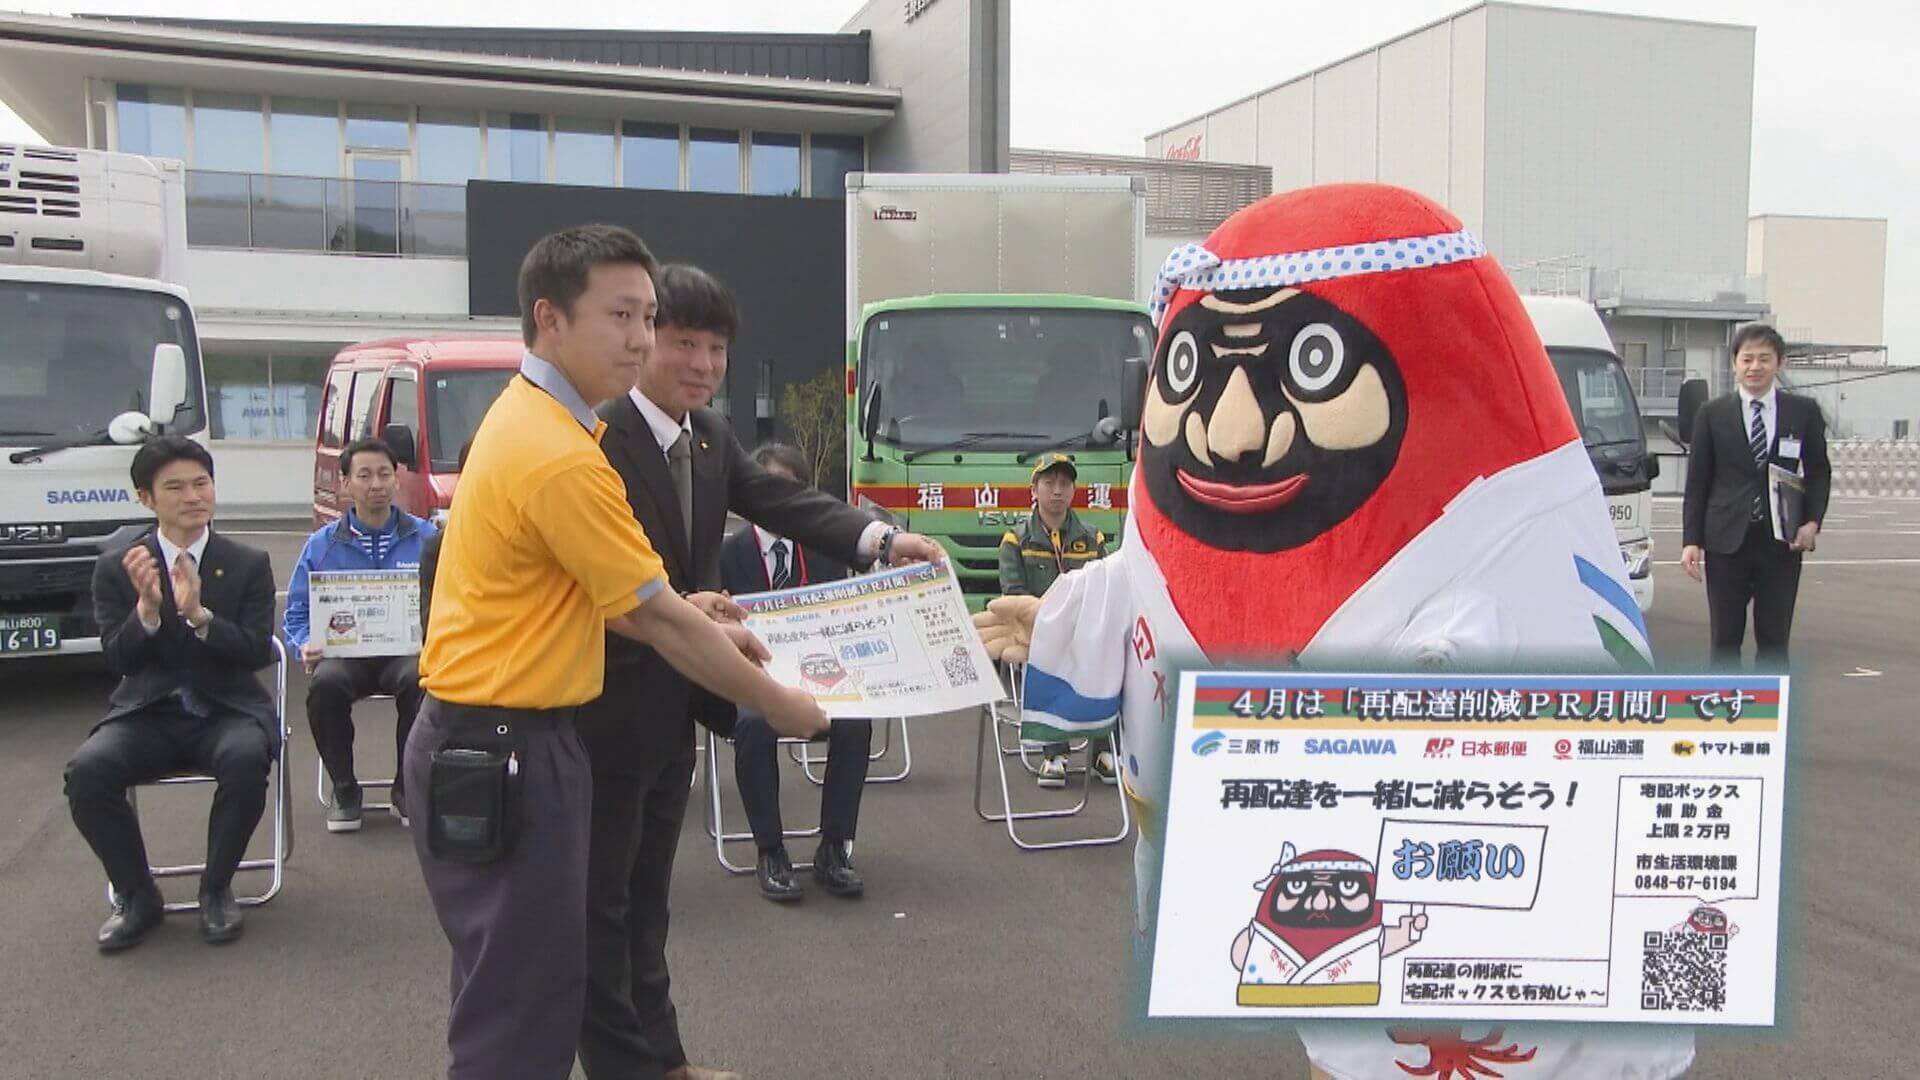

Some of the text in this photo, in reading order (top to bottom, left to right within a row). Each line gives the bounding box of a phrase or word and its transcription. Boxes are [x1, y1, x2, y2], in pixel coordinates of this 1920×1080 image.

[47, 489, 130, 504] SAGAWA
[918, 481, 1113, 511] 福山運
[978, 510, 1033, 527] ISUZ
